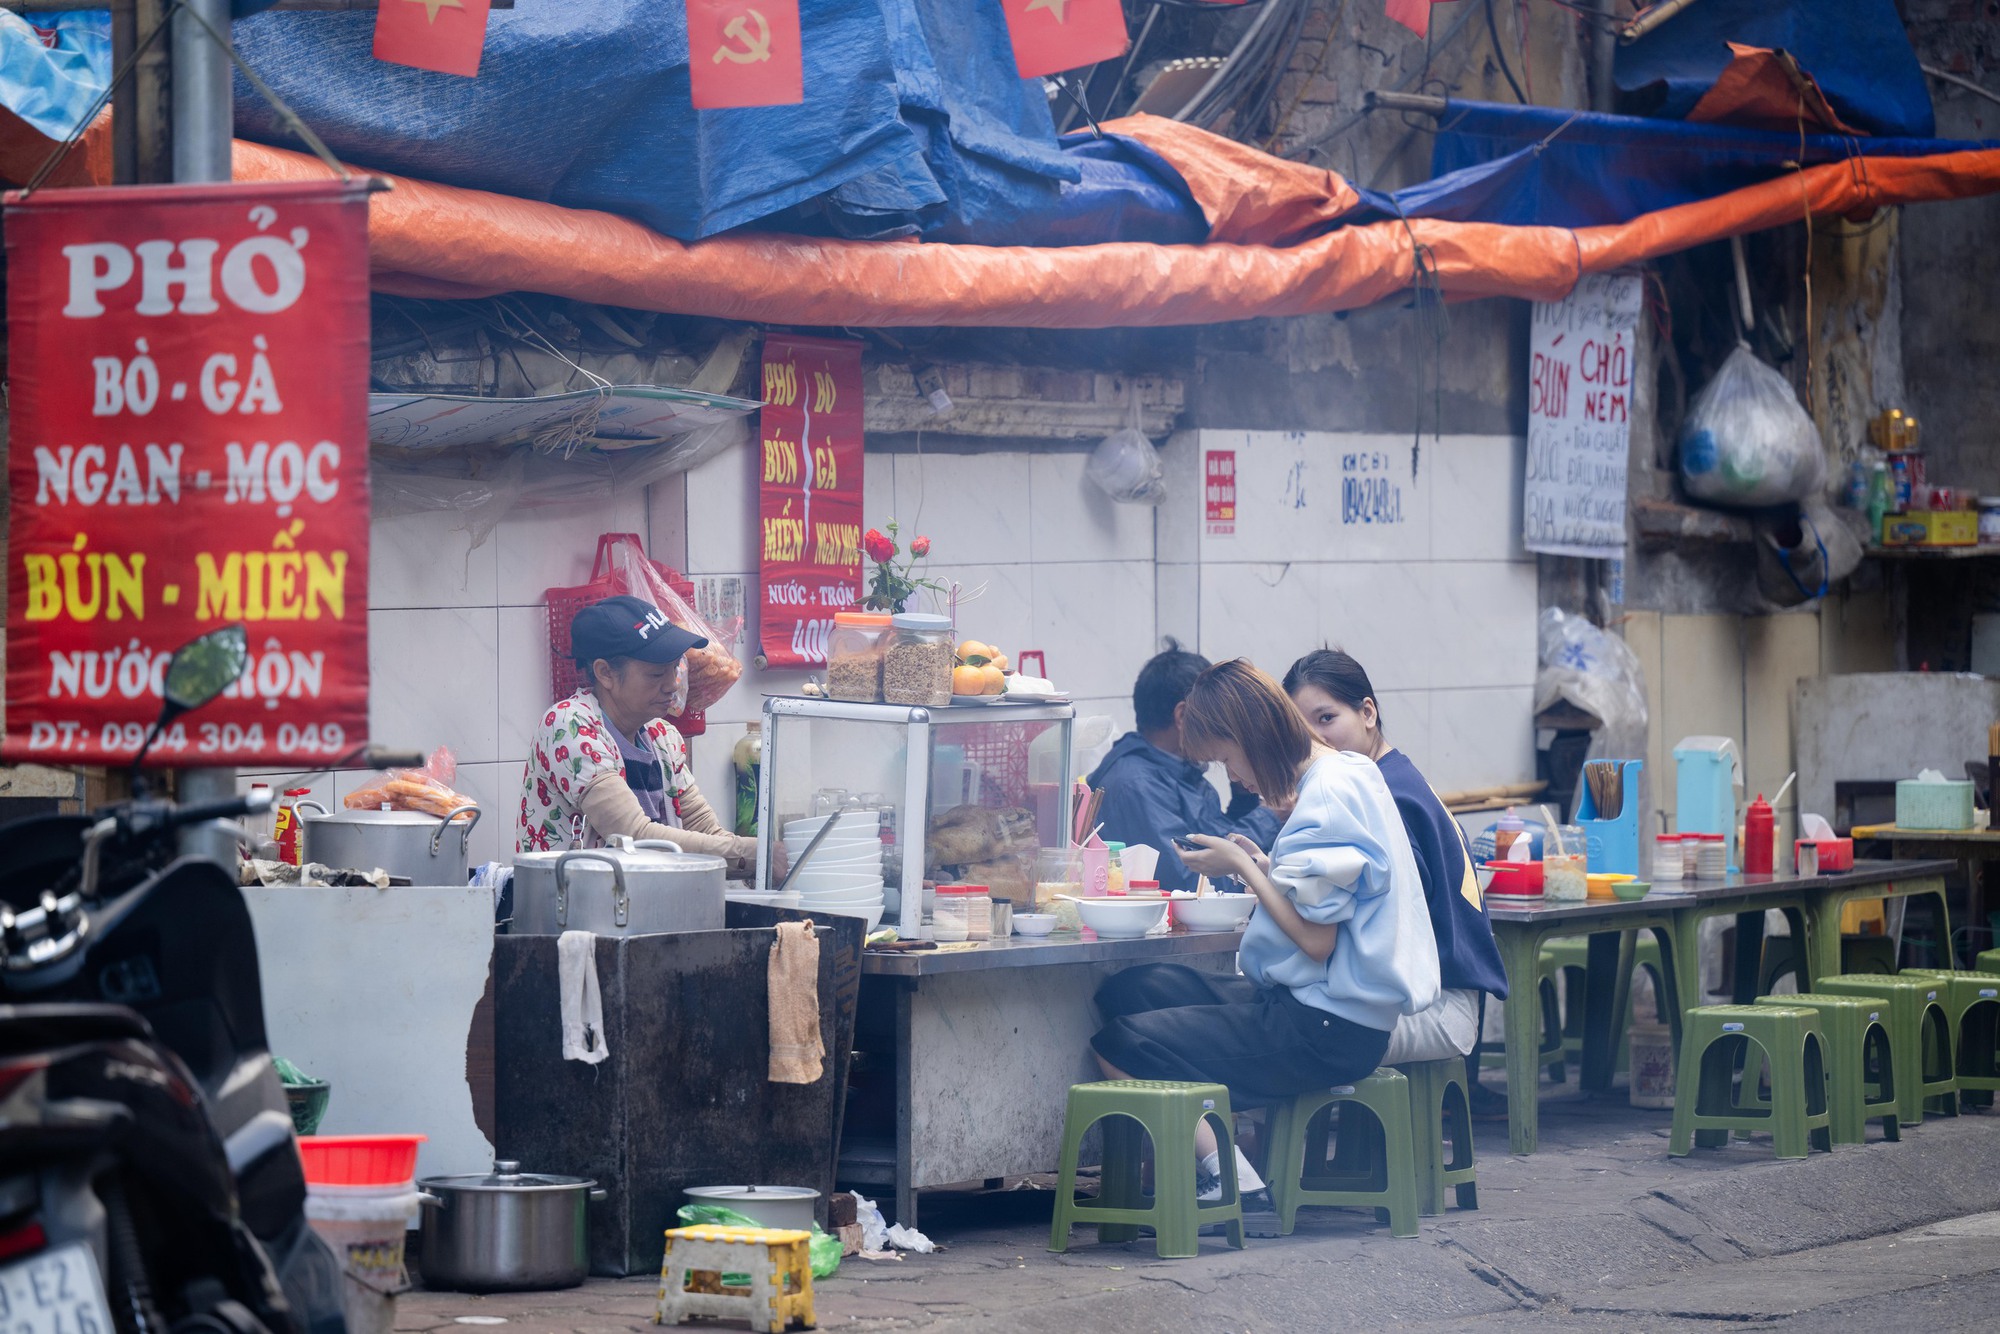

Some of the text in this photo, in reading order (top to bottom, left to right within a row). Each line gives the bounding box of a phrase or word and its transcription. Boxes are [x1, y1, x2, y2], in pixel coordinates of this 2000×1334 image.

[62, 205, 309, 318] PHỞ
[92, 338, 160, 416] BÒ
[200, 334, 282, 415] GÀ
[764, 346, 836, 415] PHỞ BÒ
[1579, 331, 1629, 387] CHẢ
[1584, 391, 1626, 422] NEM
[33, 442, 184, 506] NGAN
[224, 440, 341, 517] MỌC
[763, 427, 837, 490] BÚN GÀ
[763, 496, 804, 562] MIẾN
[814, 522, 841, 565] NGAN
[24, 532, 146, 622] BÚN
[195, 519, 349, 621] MIẾN
[768, 579, 806, 606] NƯỚC
[818, 580, 856, 611] TRỘN
[791, 618, 836, 664] 40K
[28, 721, 346, 753] ĐT: 0904 304 049
